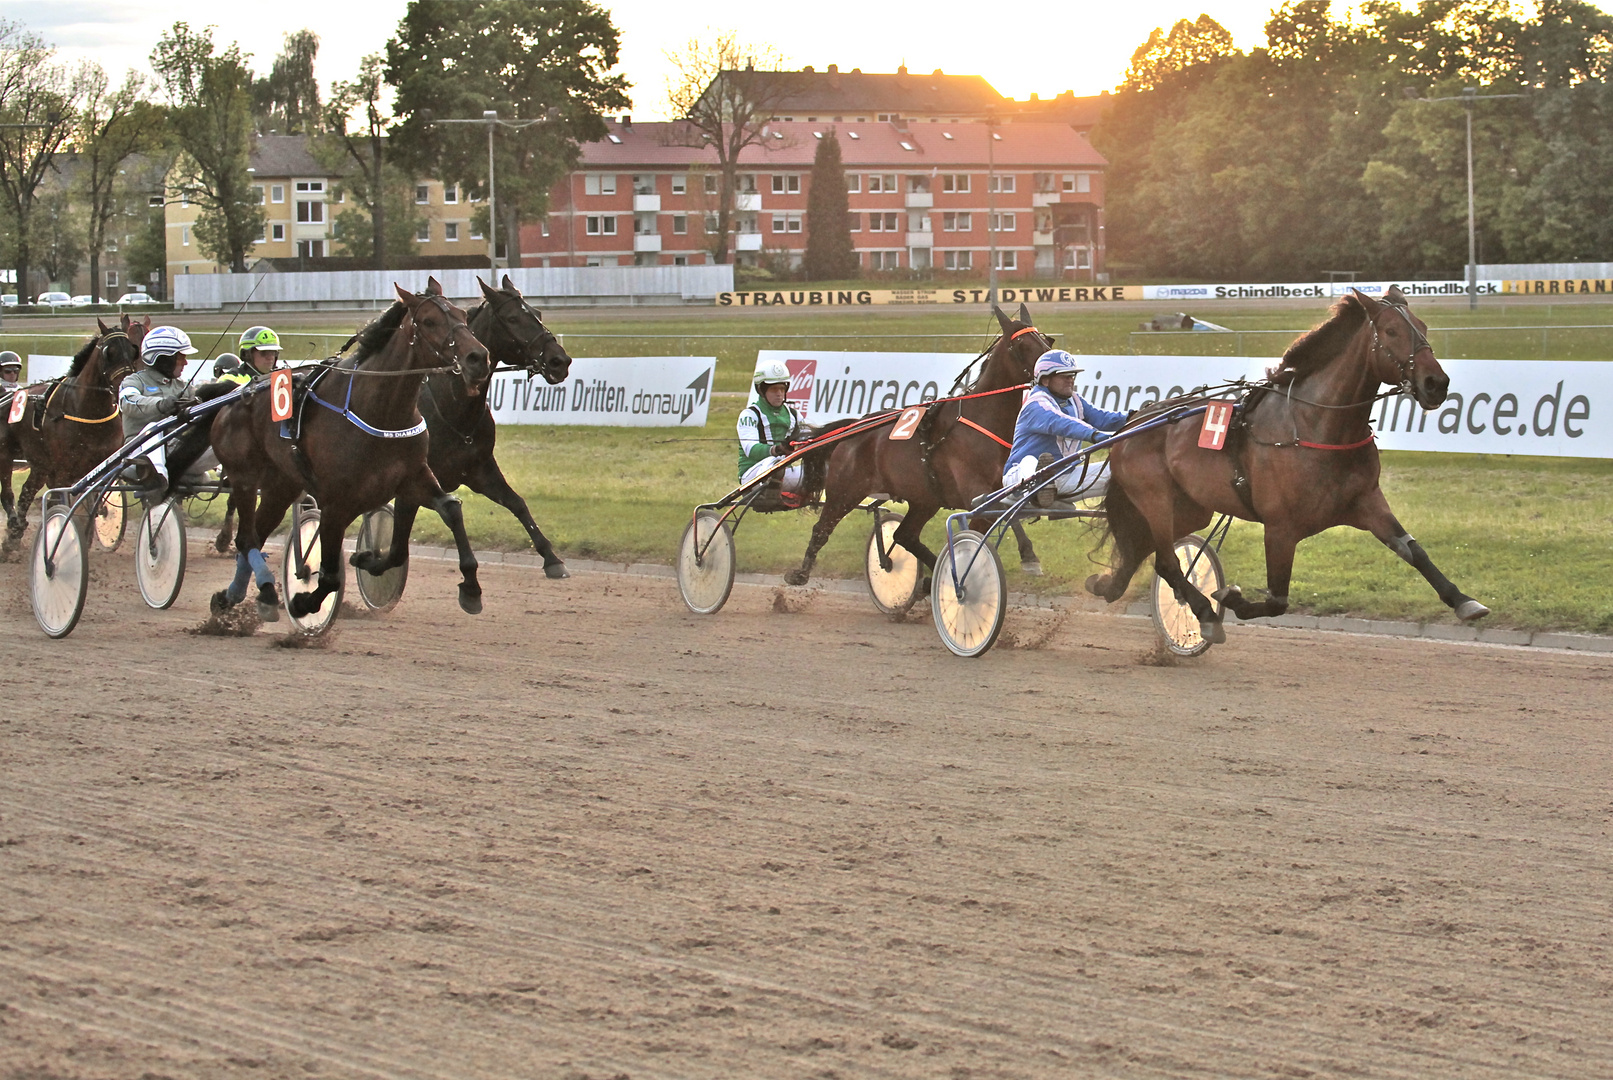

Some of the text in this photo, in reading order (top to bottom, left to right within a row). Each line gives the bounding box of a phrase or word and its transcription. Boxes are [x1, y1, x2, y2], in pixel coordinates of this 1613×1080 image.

[719, 291, 872, 306] STRAUBING
[1170, 286, 1324, 297] mazda Schindlbeck
[1525, 280, 1613, 293] IRRGAN
[11, 390, 27, 422] 3
[273, 373, 290, 416] 6
[570, 379, 628, 412] Dritten.
[892, 409, 920, 437] 2
[1205, 406, 1227, 445] 4
